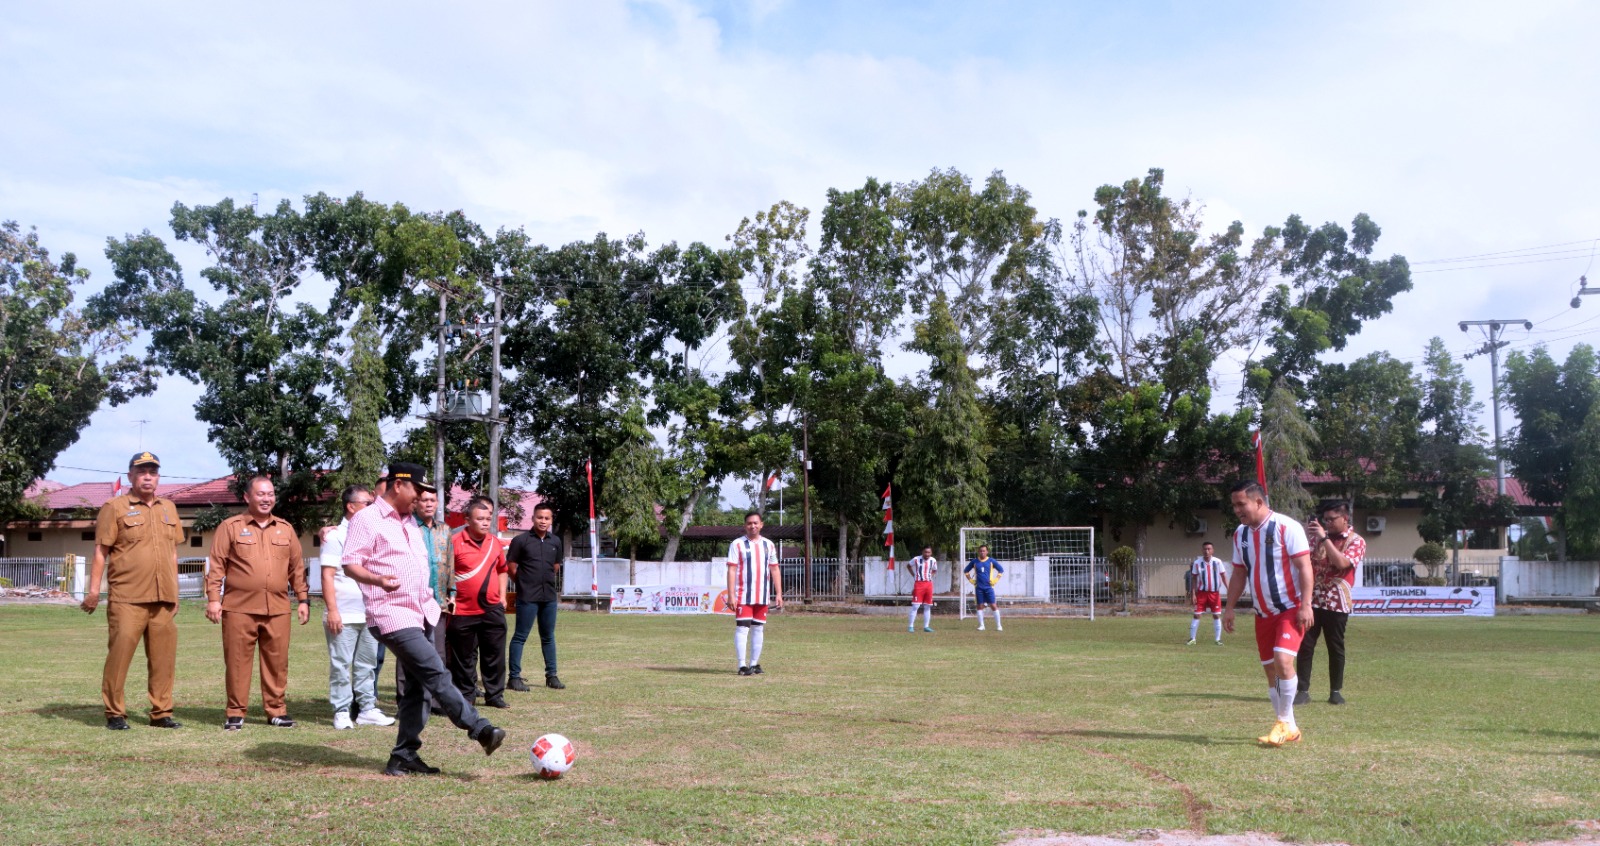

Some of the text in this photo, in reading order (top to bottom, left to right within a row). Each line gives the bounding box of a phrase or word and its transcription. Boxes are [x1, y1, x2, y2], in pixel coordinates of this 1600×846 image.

[1380, 589, 1427, 597] TURNAMEN
[665, 596, 699, 606] PON XXI
[1387, 599, 1473, 609] SOCCER
